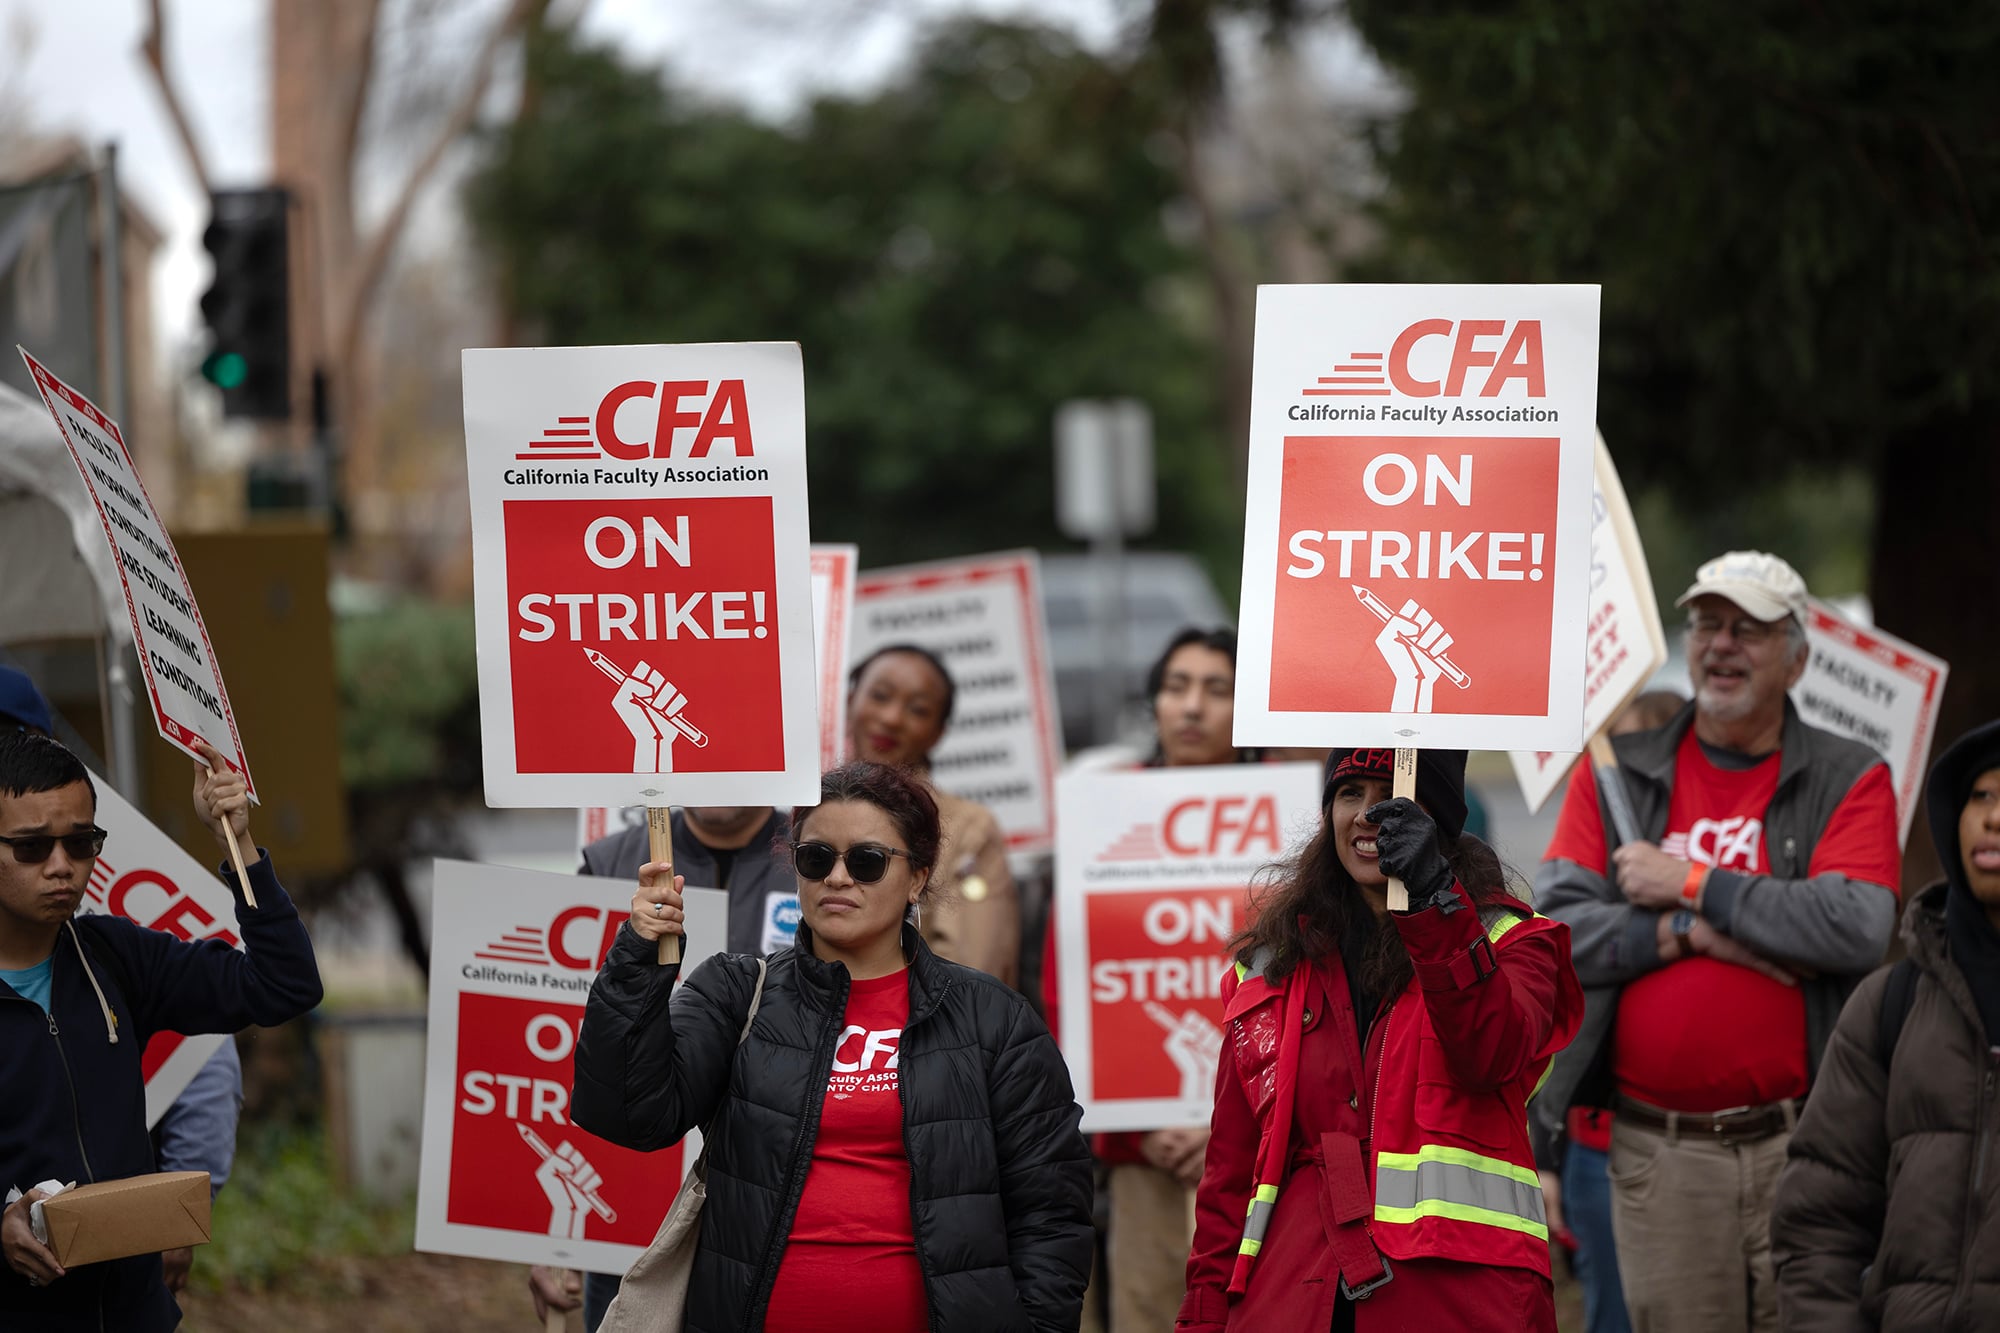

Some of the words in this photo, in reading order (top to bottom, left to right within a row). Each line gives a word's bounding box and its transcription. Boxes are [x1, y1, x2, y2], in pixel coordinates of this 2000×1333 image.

[1388, 318, 1546, 398] CFA
[66, 413, 124, 472] FACULTY
[596, 379, 754, 460] CFA
[1288, 404, 1376, 421] California
[1381, 404, 1448, 426] Faculty
[1451, 405, 1559, 422] Association
[86, 457, 149, 520] WORKING
[503, 469, 589, 485] California
[594, 467, 659, 487] Faculty
[664, 466, 769, 483] Association
[1362, 452, 1473, 507] ON
[103, 500, 176, 573] CONDITIONS
[584, 515, 691, 569] ON
[1286, 529, 1545, 582] STRIKE!
[119, 546, 145, 583] ARE
[143, 565, 196, 624] STUDENT
[142, 602, 202, 666] LEARNING
[518, 590, 768, 642] STRIKE!
[150, 650, 223, 720] CONDITIONS
[1813, 650, 1897, 708] FACULTY
[1801, 689, 1892, 751] WORKING
[1350, 747, 1394, 772] CFA
[1162, 795, 1281, 857] CFA
[1688, 816, 1763, 871] CFA
[108, 869, 239, 948] CF
[1144, 897, 1233, 946] ON
[548, 904, 633, 973] CF
[461, 964, 538, 987] California
[525, 1013, 584, 1062] O
[461, 1069, 573, 1127] STR
[826, 1084, 857, 1092] NTO
[829, 1074, 864, 1086] culty
[866, 1072, 899, 1084] Asso
